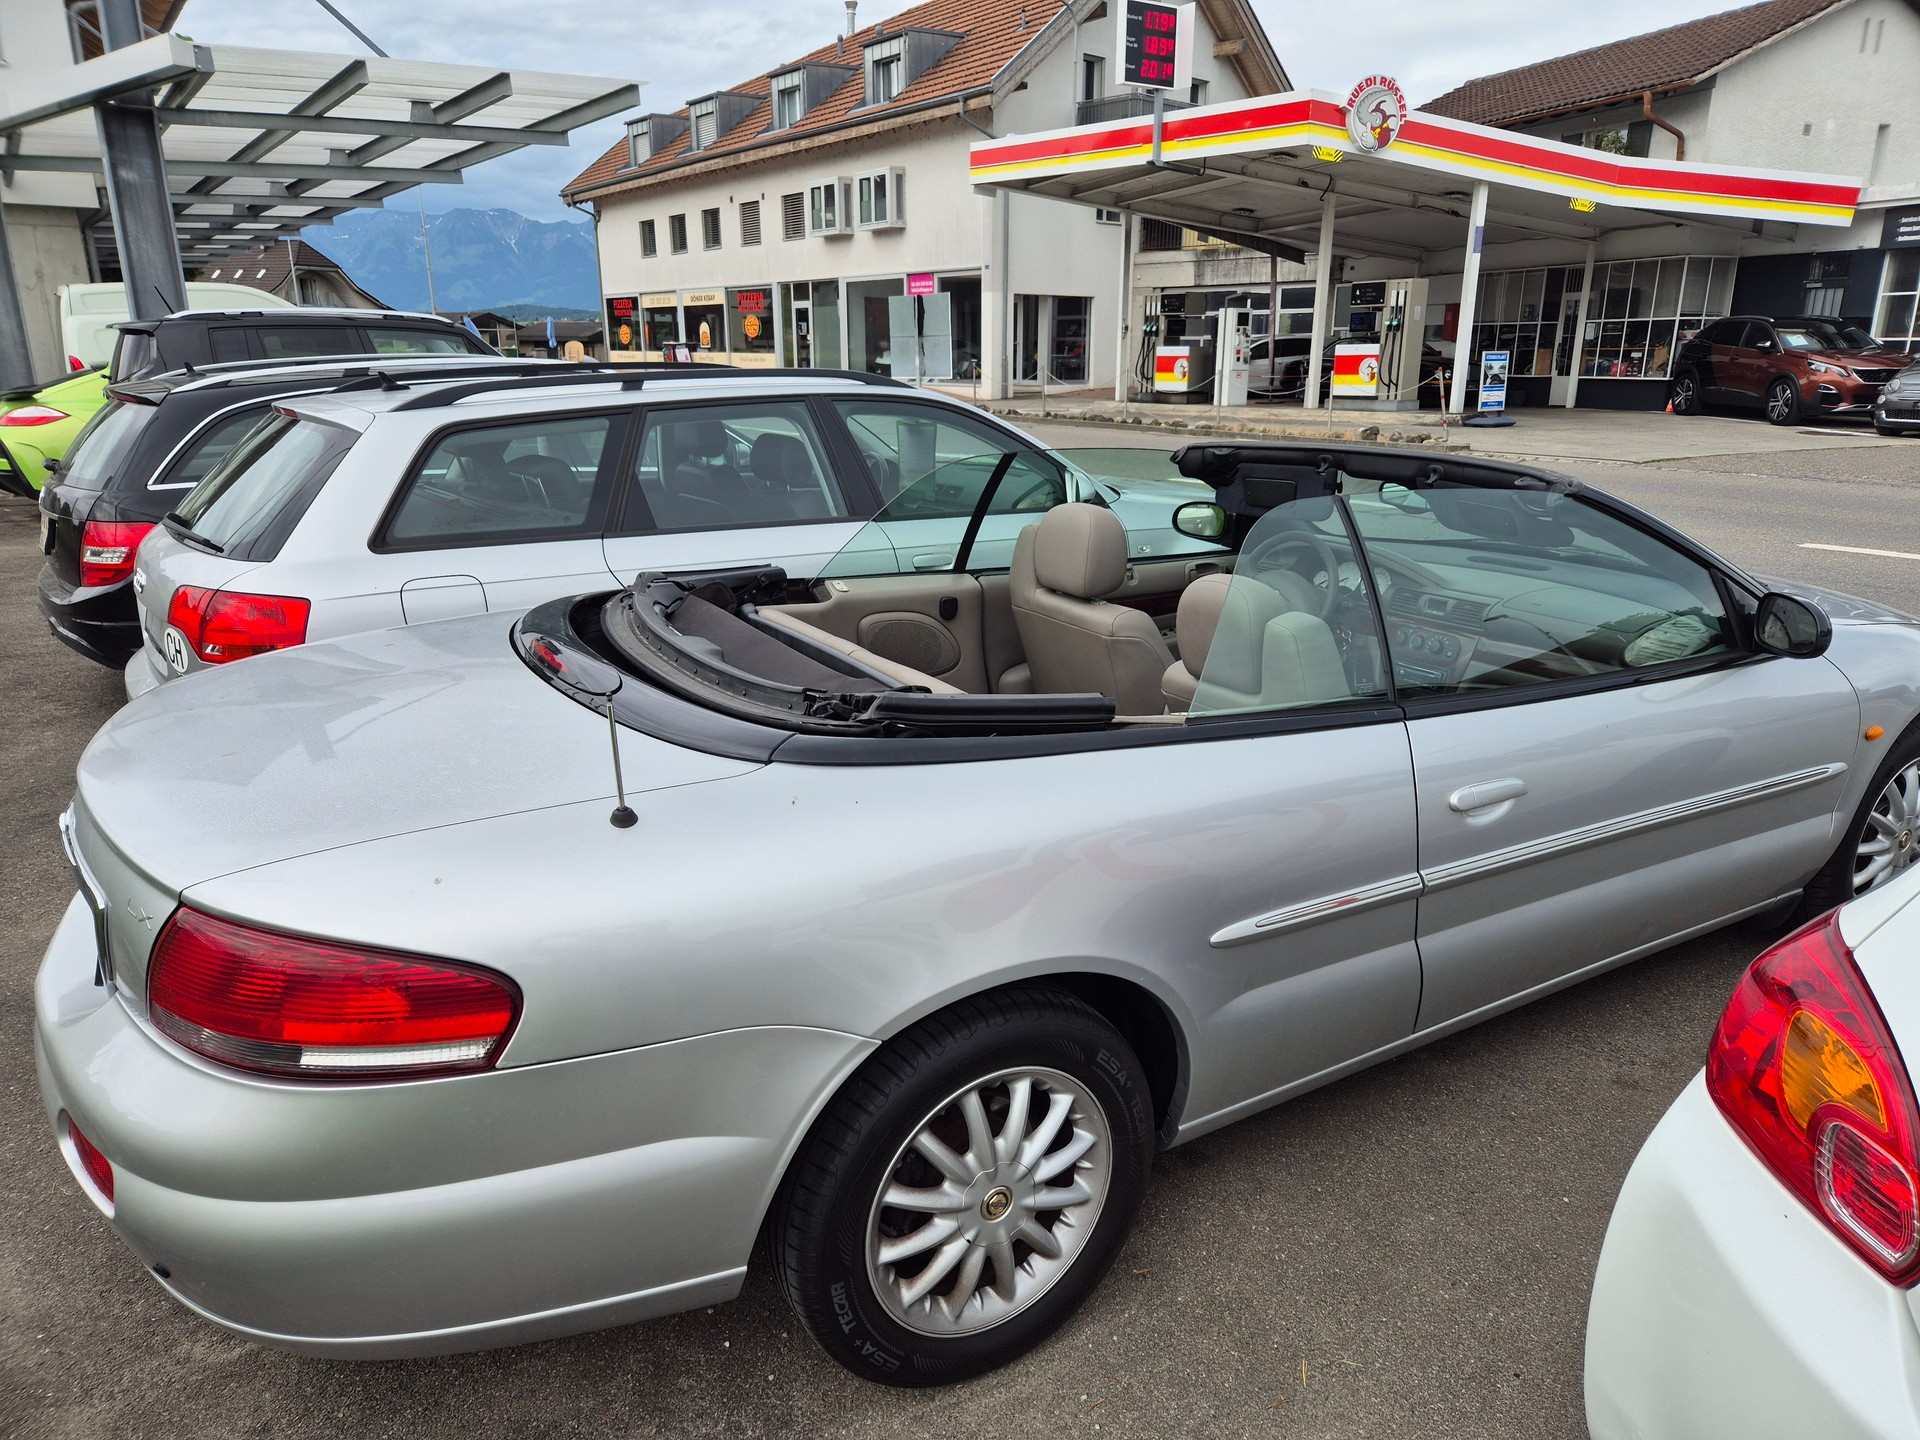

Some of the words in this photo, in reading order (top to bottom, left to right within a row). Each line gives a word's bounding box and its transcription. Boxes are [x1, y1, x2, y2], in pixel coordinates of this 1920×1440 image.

[1347, 75, 1377, 109] RUEDI
[1379, 76, 1407, 122] RÜSSEL
[613, 298, 633, 309] PIZZERIA
[690, 294, 703, 303] DÖNER
[737, 292, 765, 302] PIZZERIA
[166, 631, 185, 670] CH
[127, 896, 154, 931] LX
[831, 1282, 857, 1335] TECAR
